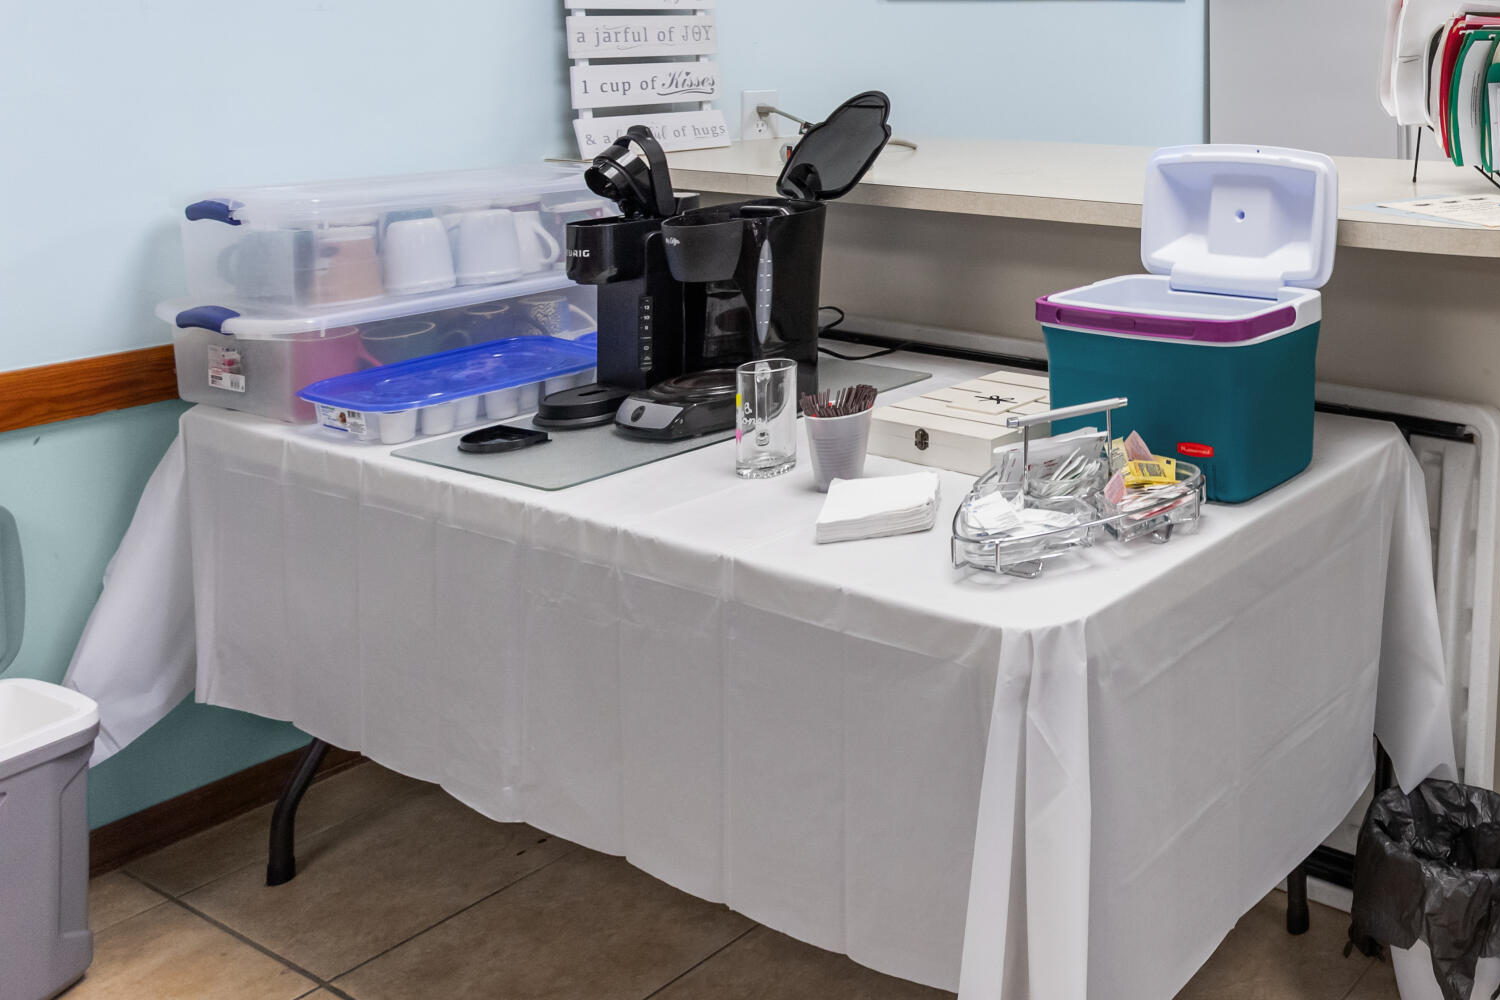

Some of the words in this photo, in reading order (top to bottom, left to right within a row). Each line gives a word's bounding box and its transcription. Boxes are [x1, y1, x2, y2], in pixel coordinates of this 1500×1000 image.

[576, 31, 586, 43] a
[594, 26, 649, 48] jarful
[657, 26, 676, 42] of
[682, 25, 713, 42] JOY
[581, 80, 590, 94] 1
[600, 80, 632, 96] cup
[640, 75, 658, 91] of
[661, 71, 716, 90] Kisses
[585, 133, 597, 146] &
[603, 134, 612, 144] a
[673, 124, 689, 138] of
[693, 124, 726, 138] hugs
[567, 249, 590, 258] URIG
